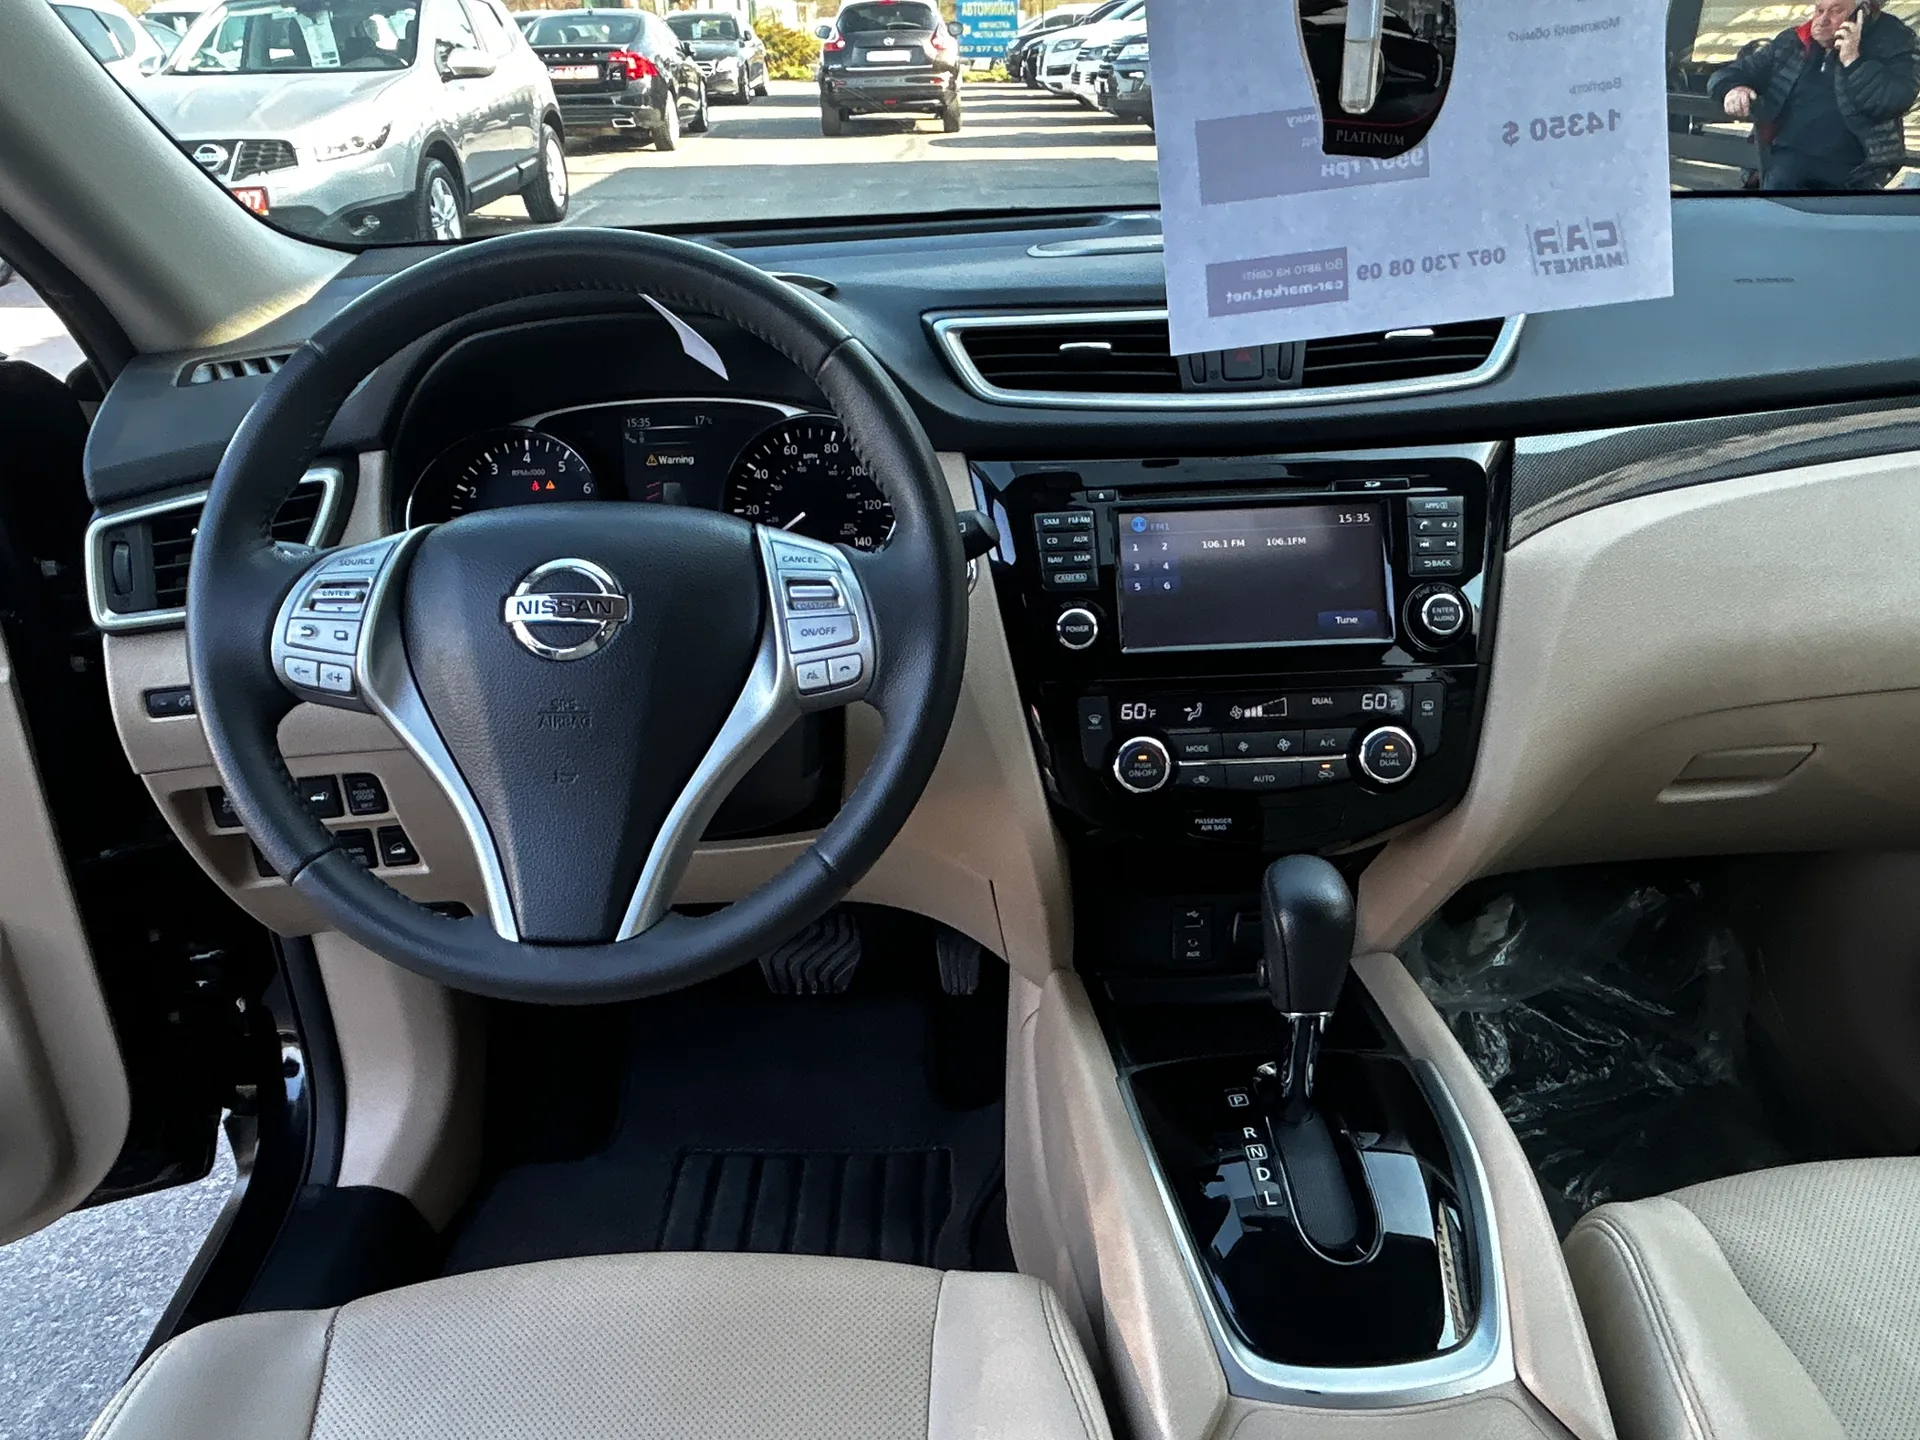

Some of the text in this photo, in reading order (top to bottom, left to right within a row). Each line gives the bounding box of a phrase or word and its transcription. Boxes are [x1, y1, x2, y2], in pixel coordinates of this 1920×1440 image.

[1335, 129, 1405, 146] PLATINUM
[626, 417, 651, 428] 15:35
[783, 444, 798, 455] 60
[824, 443, 839, 454] 80
[522, 452, 531, 463] 4
[658, 455, 695, 466] Warning
[491, 463, 499, 475] 3
[558, 460, 566, 473] 5
[850, 466, 869, 477] 100
[754, 468, 769, 480] 40
[469, 486, 477, 499] 2
[583, 482, 592, 494] 6
[745, 504, 760, 515] 20
[864, 500, 882, 510] 120
[1043, 518, 1060, 526] SXM
[1338, 512, 1371, 524] 15:35
[854, 536, 873, 547] 140
[1046, 537, 1058, 545] CD
[1073, 536, 1089, 544] AUX
[1202, 539, 1246, 549] 106.1 FM
[1132, 543, 1139, 551] 1
[1161, 542, 1168, 550] 2
[339, 557, 376, 567] SOURCE
[781, 555, 819, 564] CANCEL
[1047, 556, 1063, 564] NAV
[1133, 563, 1140, 571] 3
[1162, 561, 1169, 570] 4
[1134, 582, 1141, 591] 5
[1163, 581, 1171, 590] 6
[515, 599, 614, 615] NISSAN
[1432, 606, 1455, 614] ENTER
[1335, 615, 1358, 624] Tune
[1433, 614, 1455, 622] AUDIO
[801, 627, 838, 637] ON/OFF
[1312, 697, 1333, 705] DUAL
[1320, 738, 1336, 747] A/C
[1185, 745, 1209, 753] MODE
[1253, 775, 1276, 783] AUTO
[1195, 817, 1232, 825] PASSENGER
[1233, 1095, 1244, 1105] P
[1243, 1127, 1257, 1139] R
[1250, 1146, 1263, 1158] N
[1256, 1167, 1270, 1181] D
[1263, 1190, 1277, 1206] L
